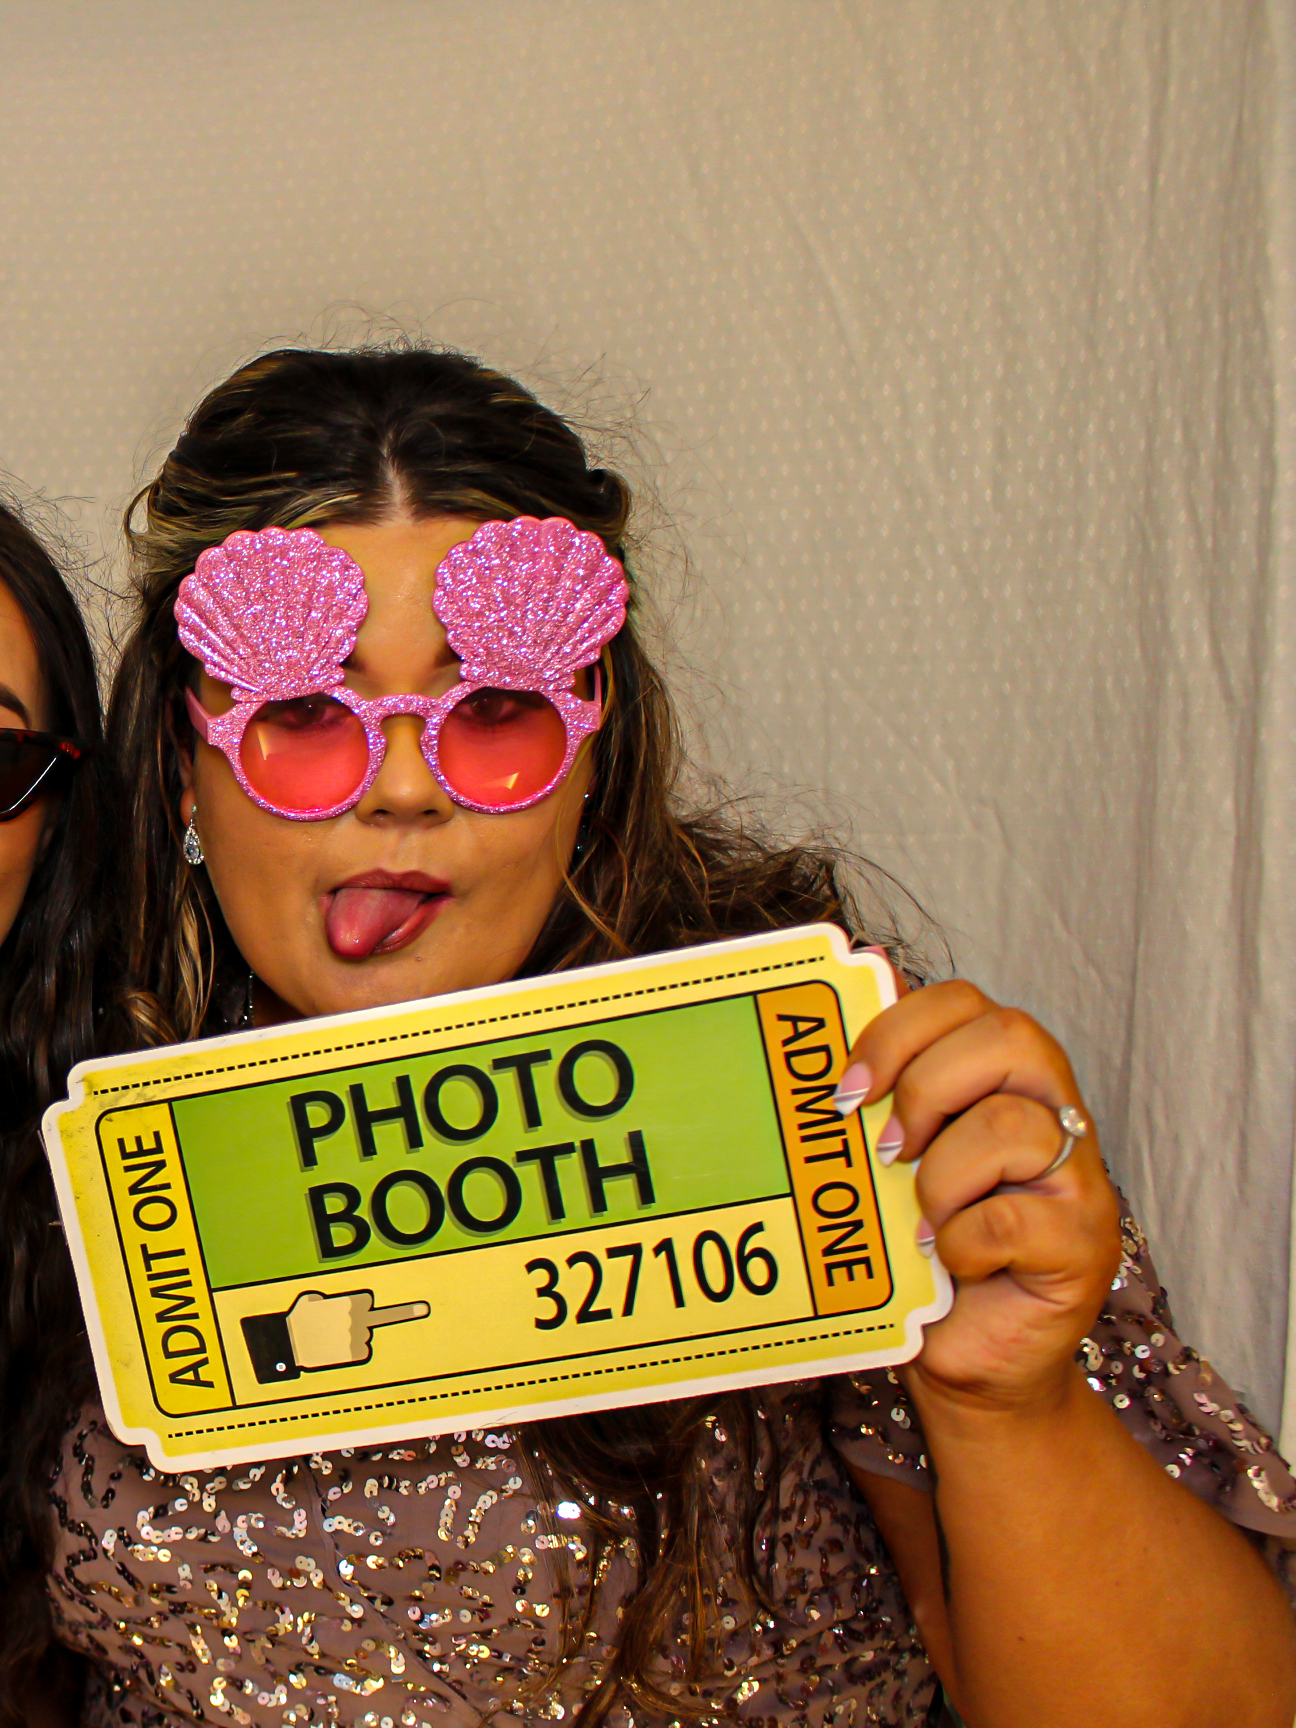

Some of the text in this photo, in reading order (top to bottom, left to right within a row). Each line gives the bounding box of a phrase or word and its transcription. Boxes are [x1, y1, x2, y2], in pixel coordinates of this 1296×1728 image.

[288, 1038, 635, 1170] PHOTO
[776, 1012, 874, 1288] ADMIT ONE
[116, 1129, 216, 1390] ADMIT ONE
[306, 1129, 657, 1261] BOOTH
[523, 1221, 779, 1331] 327106
